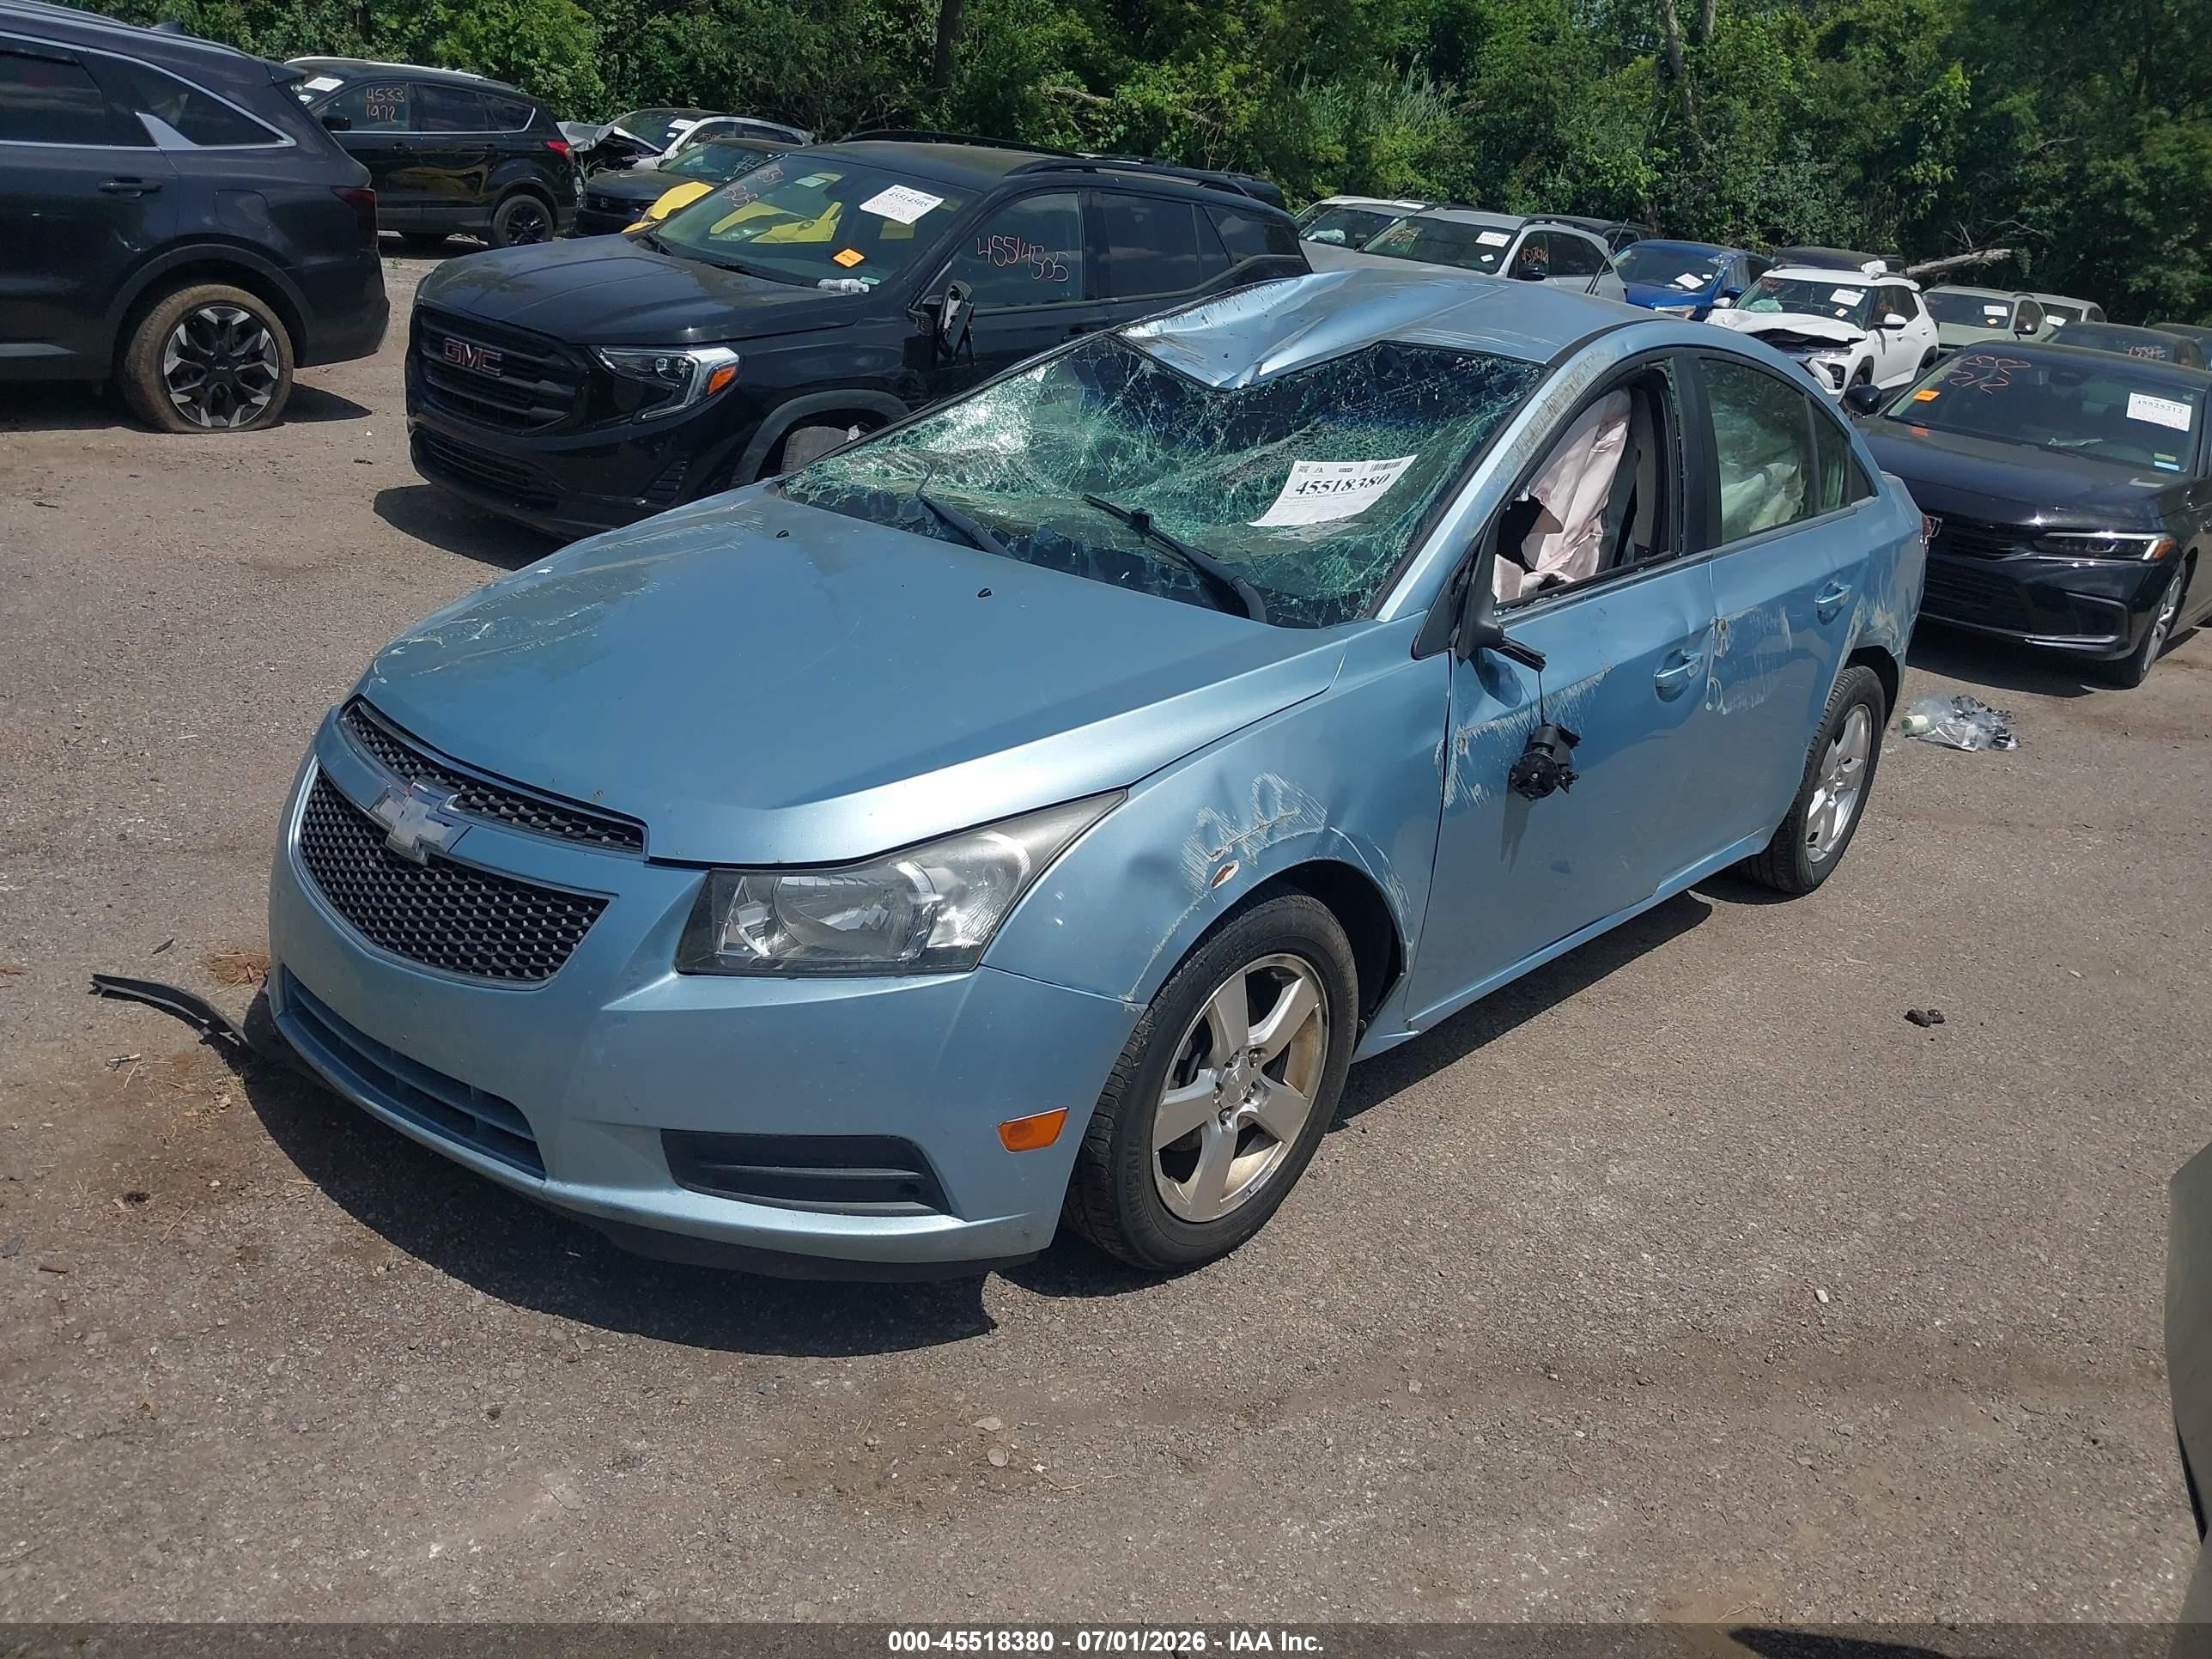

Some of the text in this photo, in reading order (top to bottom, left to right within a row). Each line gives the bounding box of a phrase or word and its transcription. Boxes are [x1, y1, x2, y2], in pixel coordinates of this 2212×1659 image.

[366, 88, 404, 103] 4533
[366, 103, 398, 123] 1972
[443, 337, 502, 377] GMC
[2136, 399, 2183, 414] 45525212
[1295, 473, 1391, 495] 45518380
